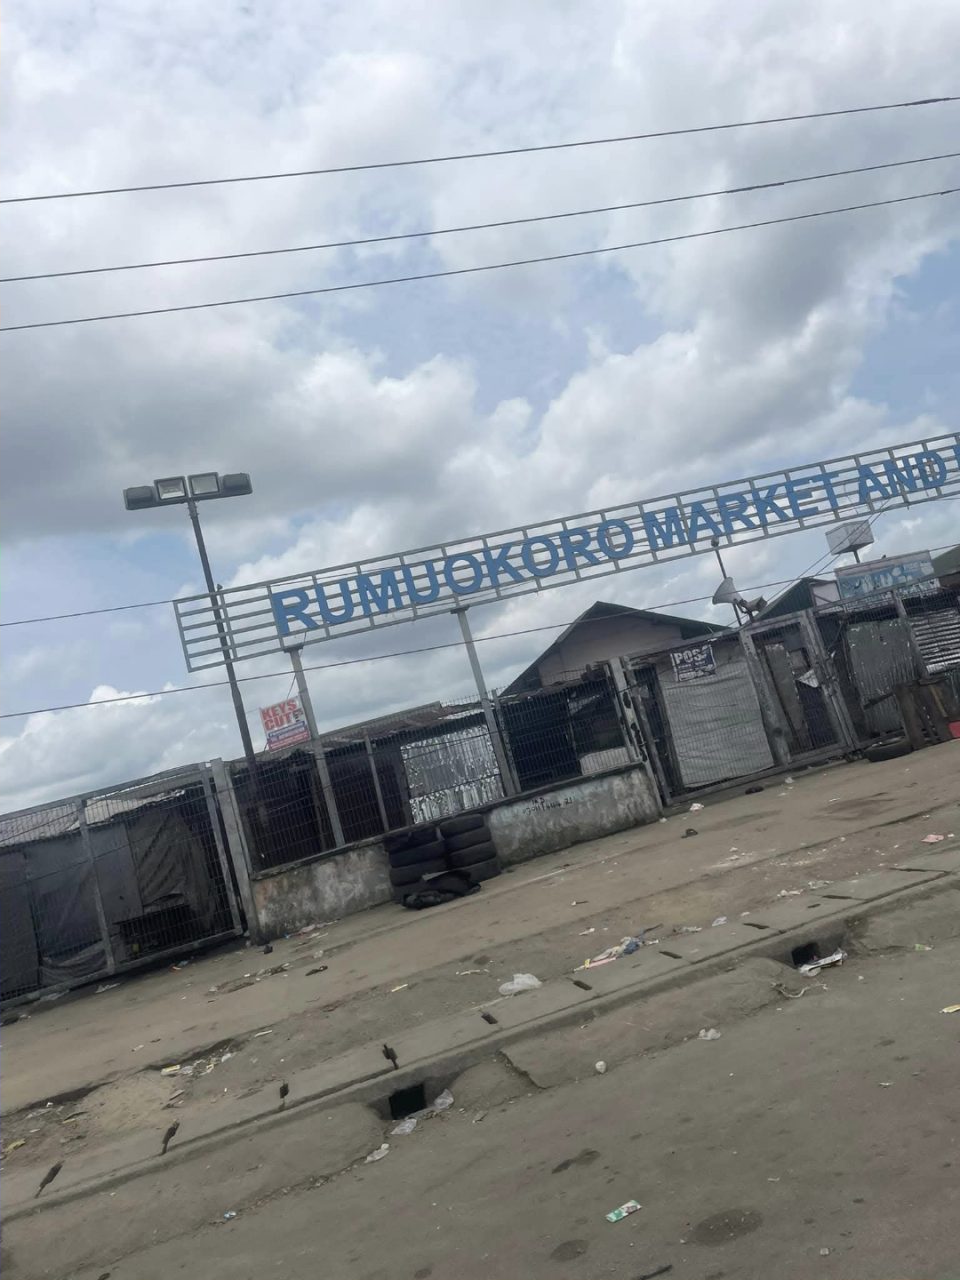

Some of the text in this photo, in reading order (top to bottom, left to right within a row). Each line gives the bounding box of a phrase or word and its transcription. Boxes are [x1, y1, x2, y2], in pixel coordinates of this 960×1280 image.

[271, 449, 948, 636] RUMUOKORO MARKET AND
[261, 698, 298, 721] KEYS
